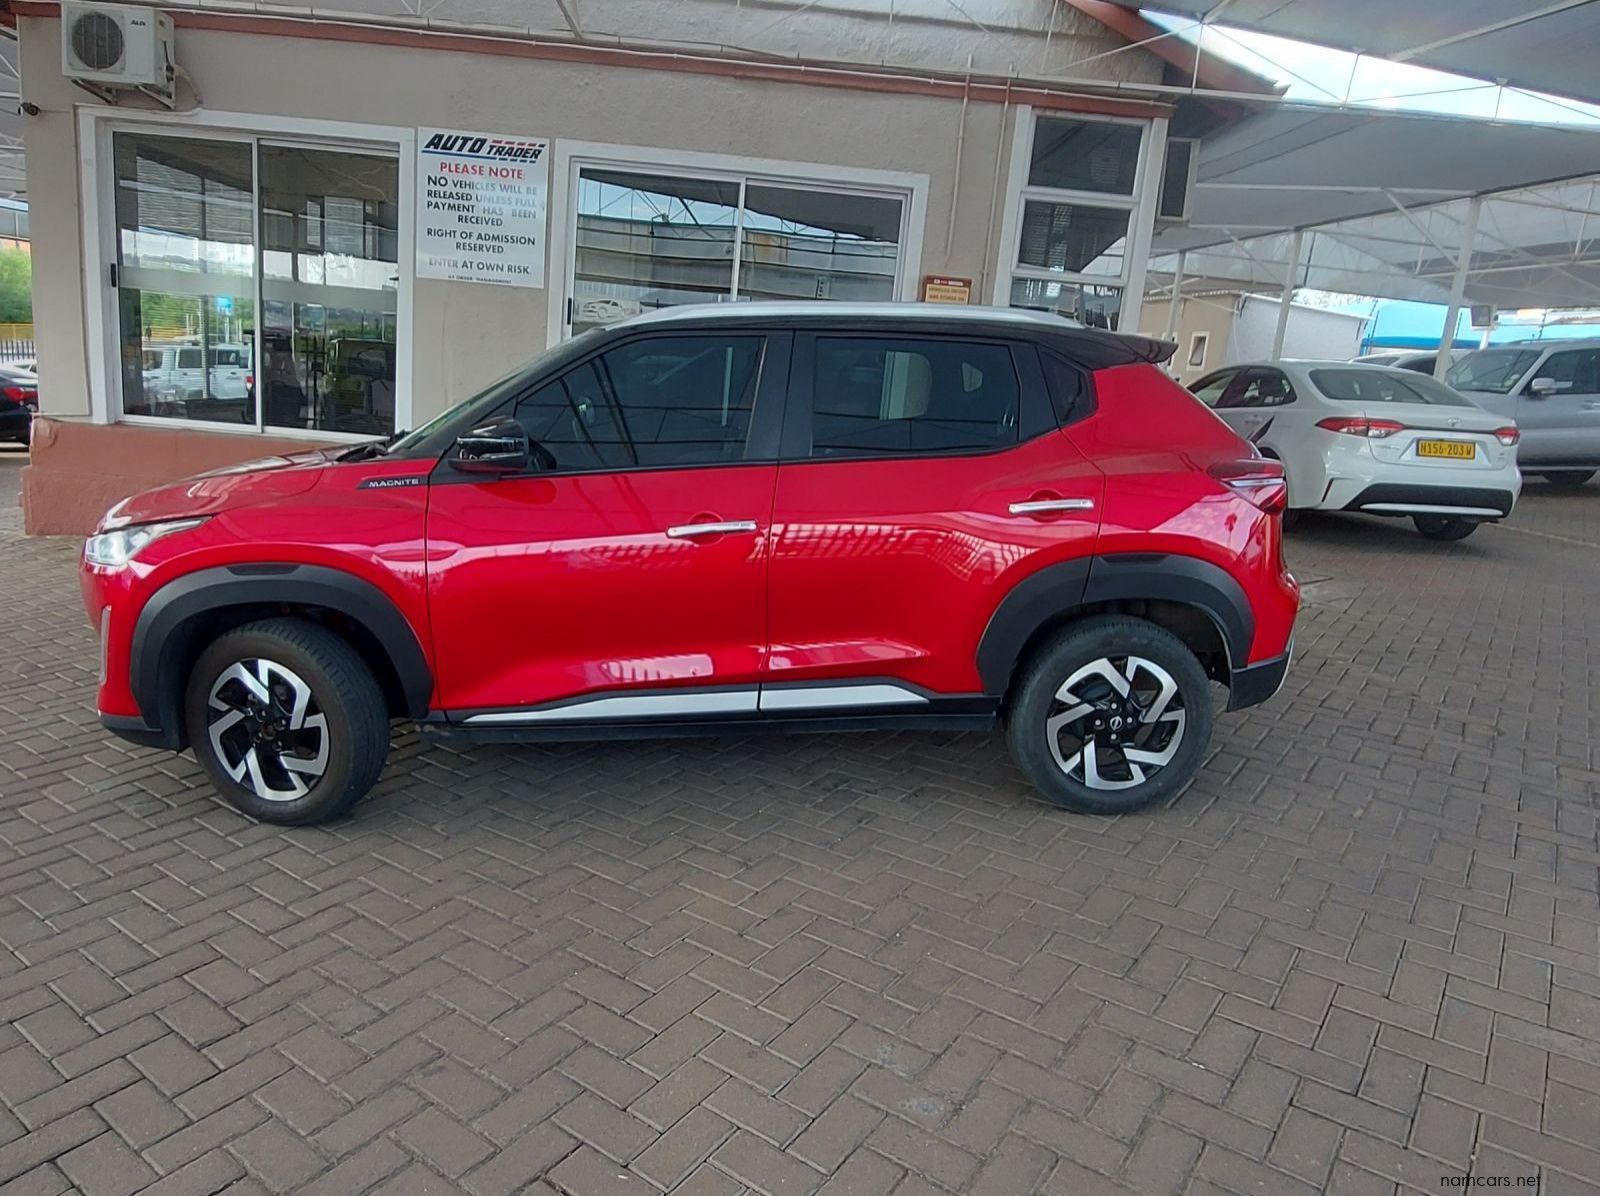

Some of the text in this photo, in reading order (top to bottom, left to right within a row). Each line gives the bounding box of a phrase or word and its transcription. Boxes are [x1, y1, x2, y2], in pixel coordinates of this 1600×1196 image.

[424, 133, 542, 160] AUTO TRADER
[440, 162, 484, 176] PLEASE
[427, 175, 537, 195] NO VEHICLES WILL BE
[427, 189, 537, 208] RELEASED UNLESS FULL
[427, 201, 537, 219] PAYMENT HAS BEEN
[457, 215, 503, 227] RECEIVED
[426, 228, 536, 246] RIGHT OF ADMISSION
[455, 242, 504, 254] RESERVED
[428, 257, 459, 269] ENTER
[461, 261, 474, 270] AT
[476, 262, 504, 273] OWN
[369, 478, 419, 488] MAGNITE
